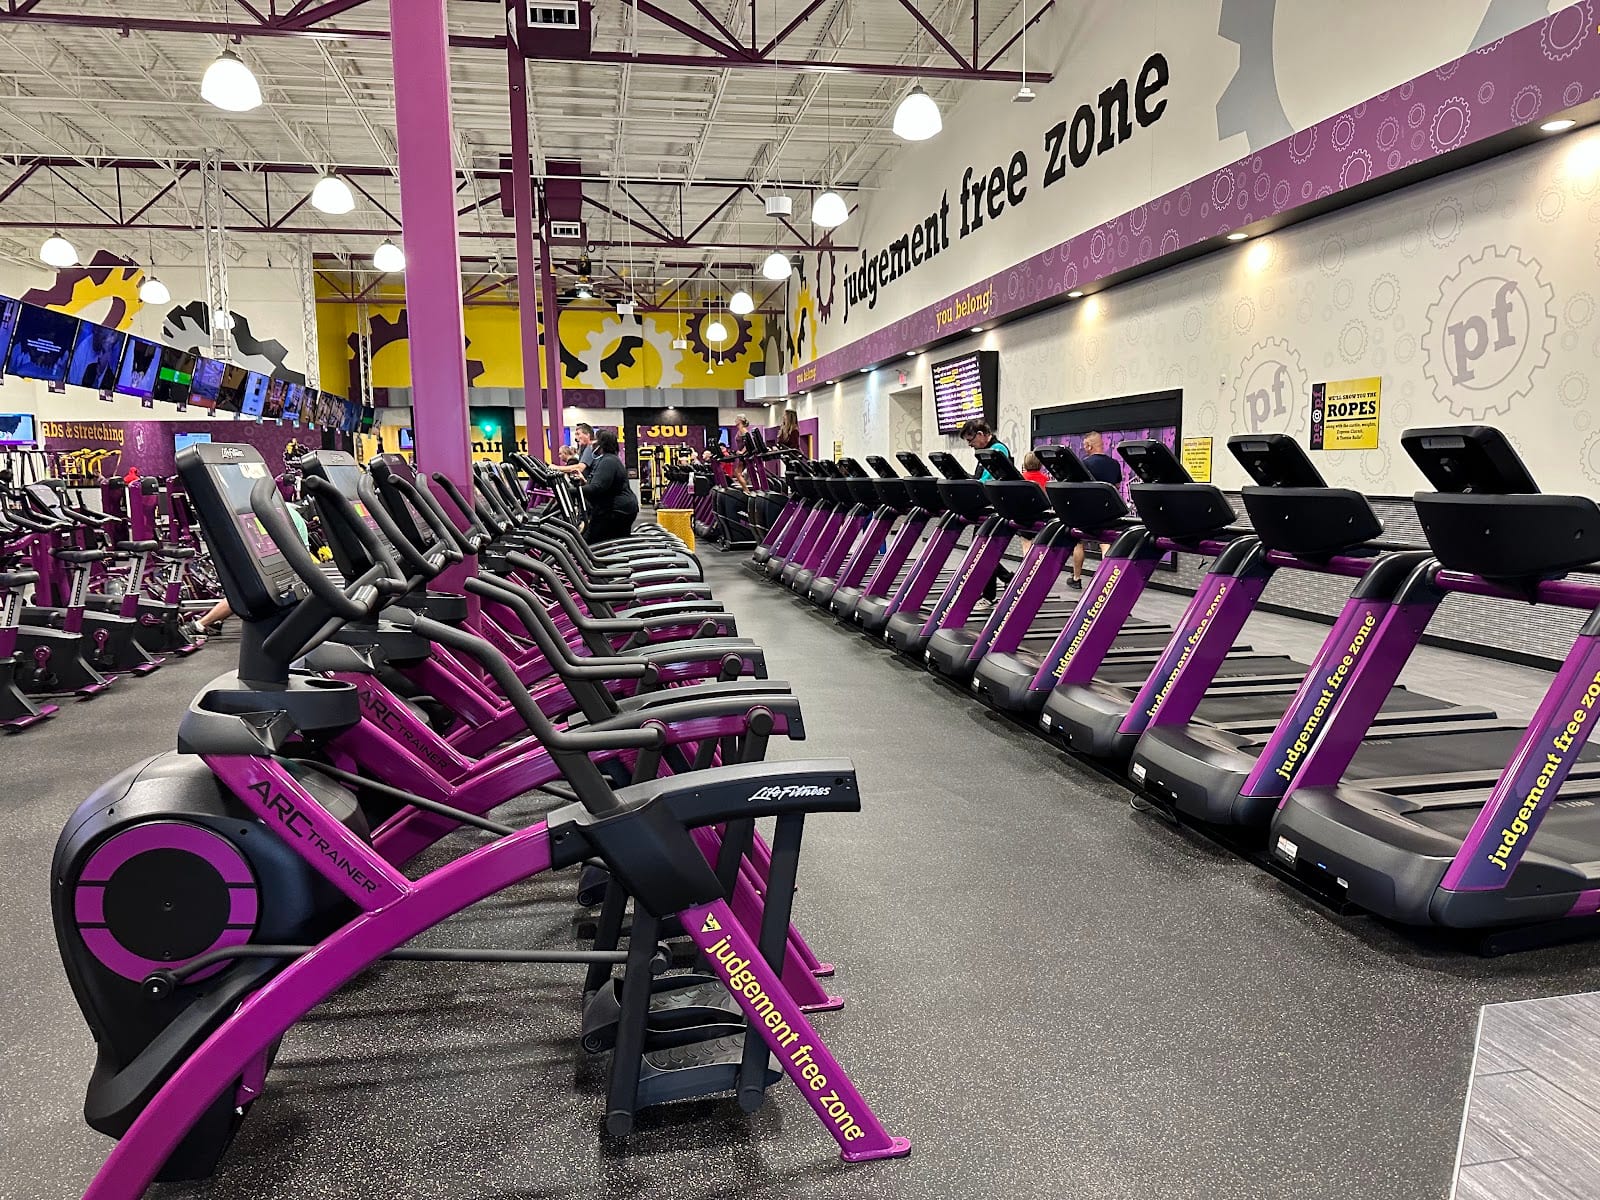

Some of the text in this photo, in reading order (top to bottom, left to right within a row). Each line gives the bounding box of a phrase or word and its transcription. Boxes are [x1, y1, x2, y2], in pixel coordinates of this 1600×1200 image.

[843, 52, 1169, 324] judgement free zone
[936, 283, 993, 333] you belong!
[1448, 280, 1518, 386] pf
[42, 422, 64, 437] abs
[74, 423, 124, 446] stretching
[1327, 400, 1376, 417] ROPES
[1052, 568, 1121, 679] judgement free zone
[399, 726, 448, 770] TRAINER
[1275, 614, 1376, 781] judgement free zone
[248, 780, 378, 894] ARC TRAINER
[1488, 752, 1562, 871] judgement
[1553, 709, 1587, 753] free
[705, 935, 865, 1141] judgement free zone
